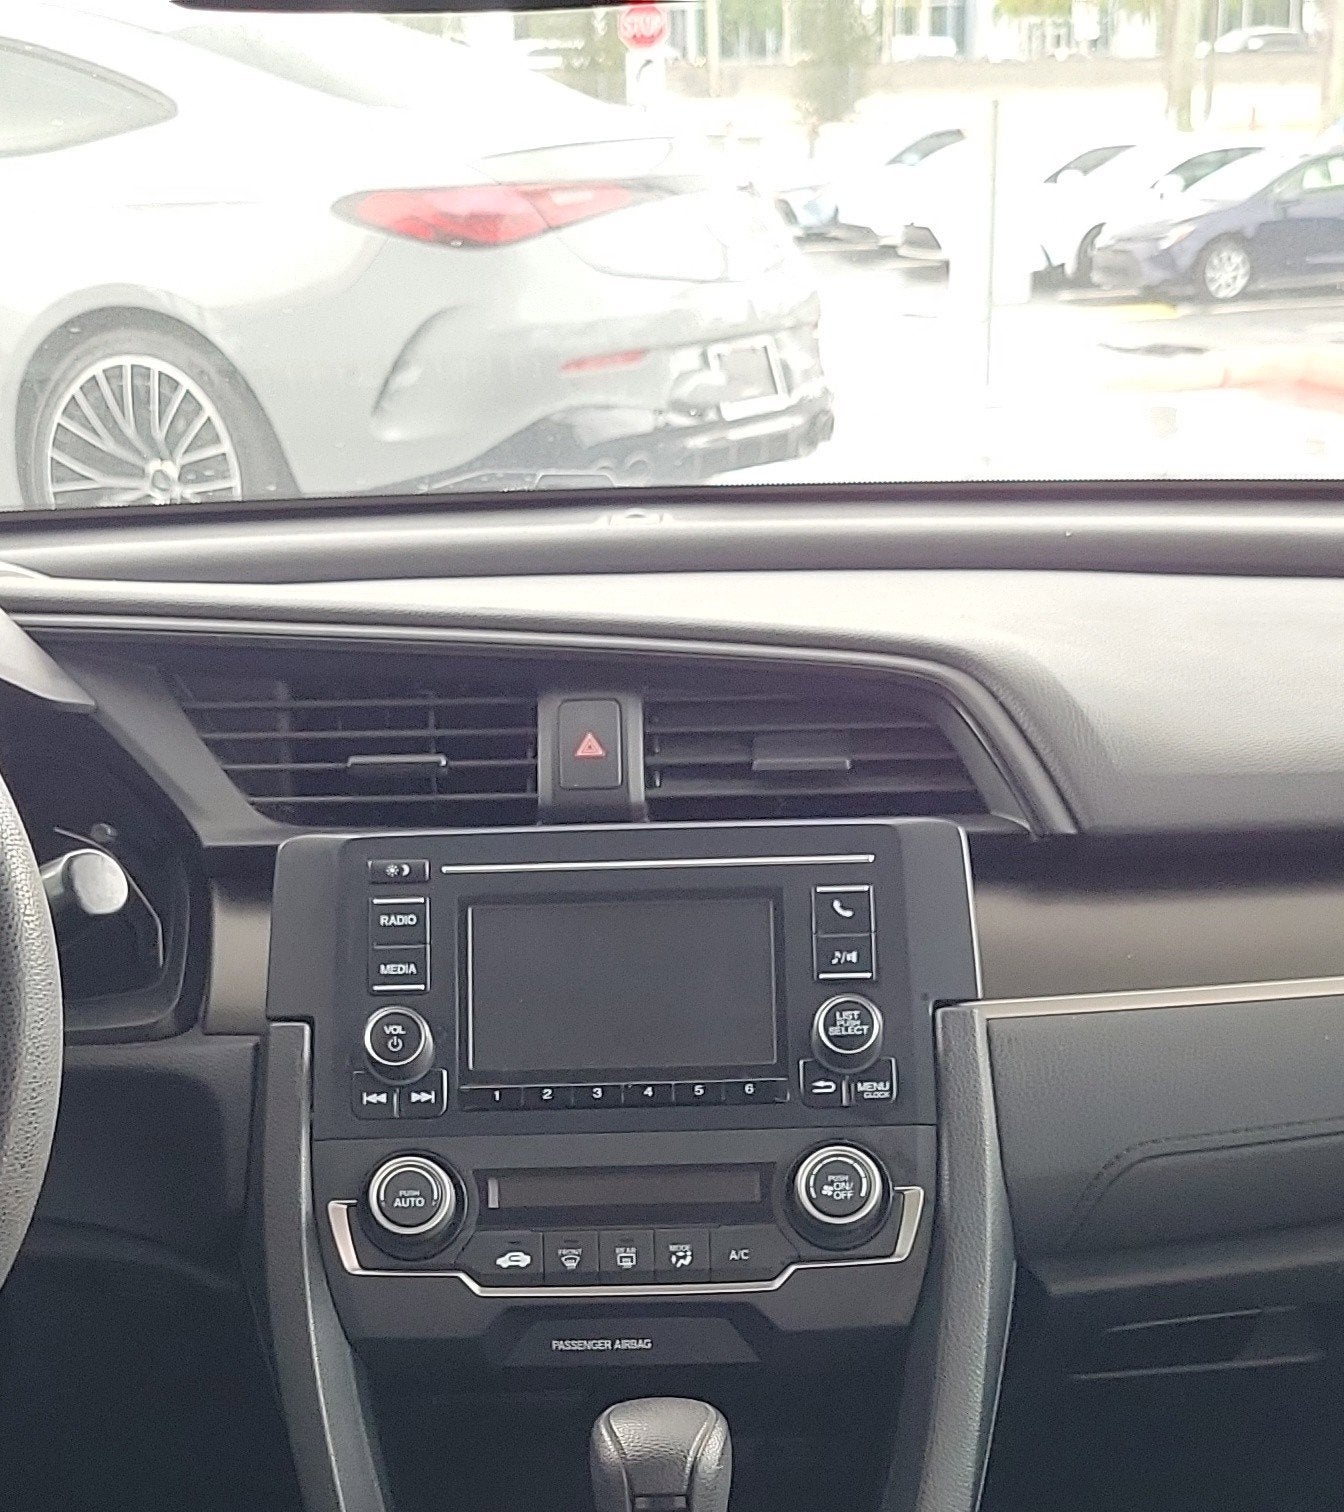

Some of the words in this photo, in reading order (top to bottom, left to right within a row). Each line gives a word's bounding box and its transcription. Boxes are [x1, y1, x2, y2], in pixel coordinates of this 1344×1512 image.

[379, 914, 417, 927] RADIO
[379, 963, 417, 975] MEDIA
[836, 1010, 861, 1020] LIST
[383, 1025, 406, 1035] VOL
[828, 1025, 869, 1036] SELECT
[494, 1090, 500, 1101] 1
[542, 1088, 553, 1100] 2
[592, 1087, 603, 1099] 3
[643, 1086, 654, 1097] 4
[694, 1084, 705, 1096] 5
[744, 1083, 755, 1095] 6
[857, 1081, 891, 1092] MENU
[863, 1091, 890, 1099] CLOCK
[833, 1190, 854, 1200] OFF
[393, 1197, 425, 1208] AUTO
[729, 1249, 750, 1260] A/C
[552, 1339, 612, 1351] PASSENGER
[613, 1339, 653, 1349] AIRBAG
